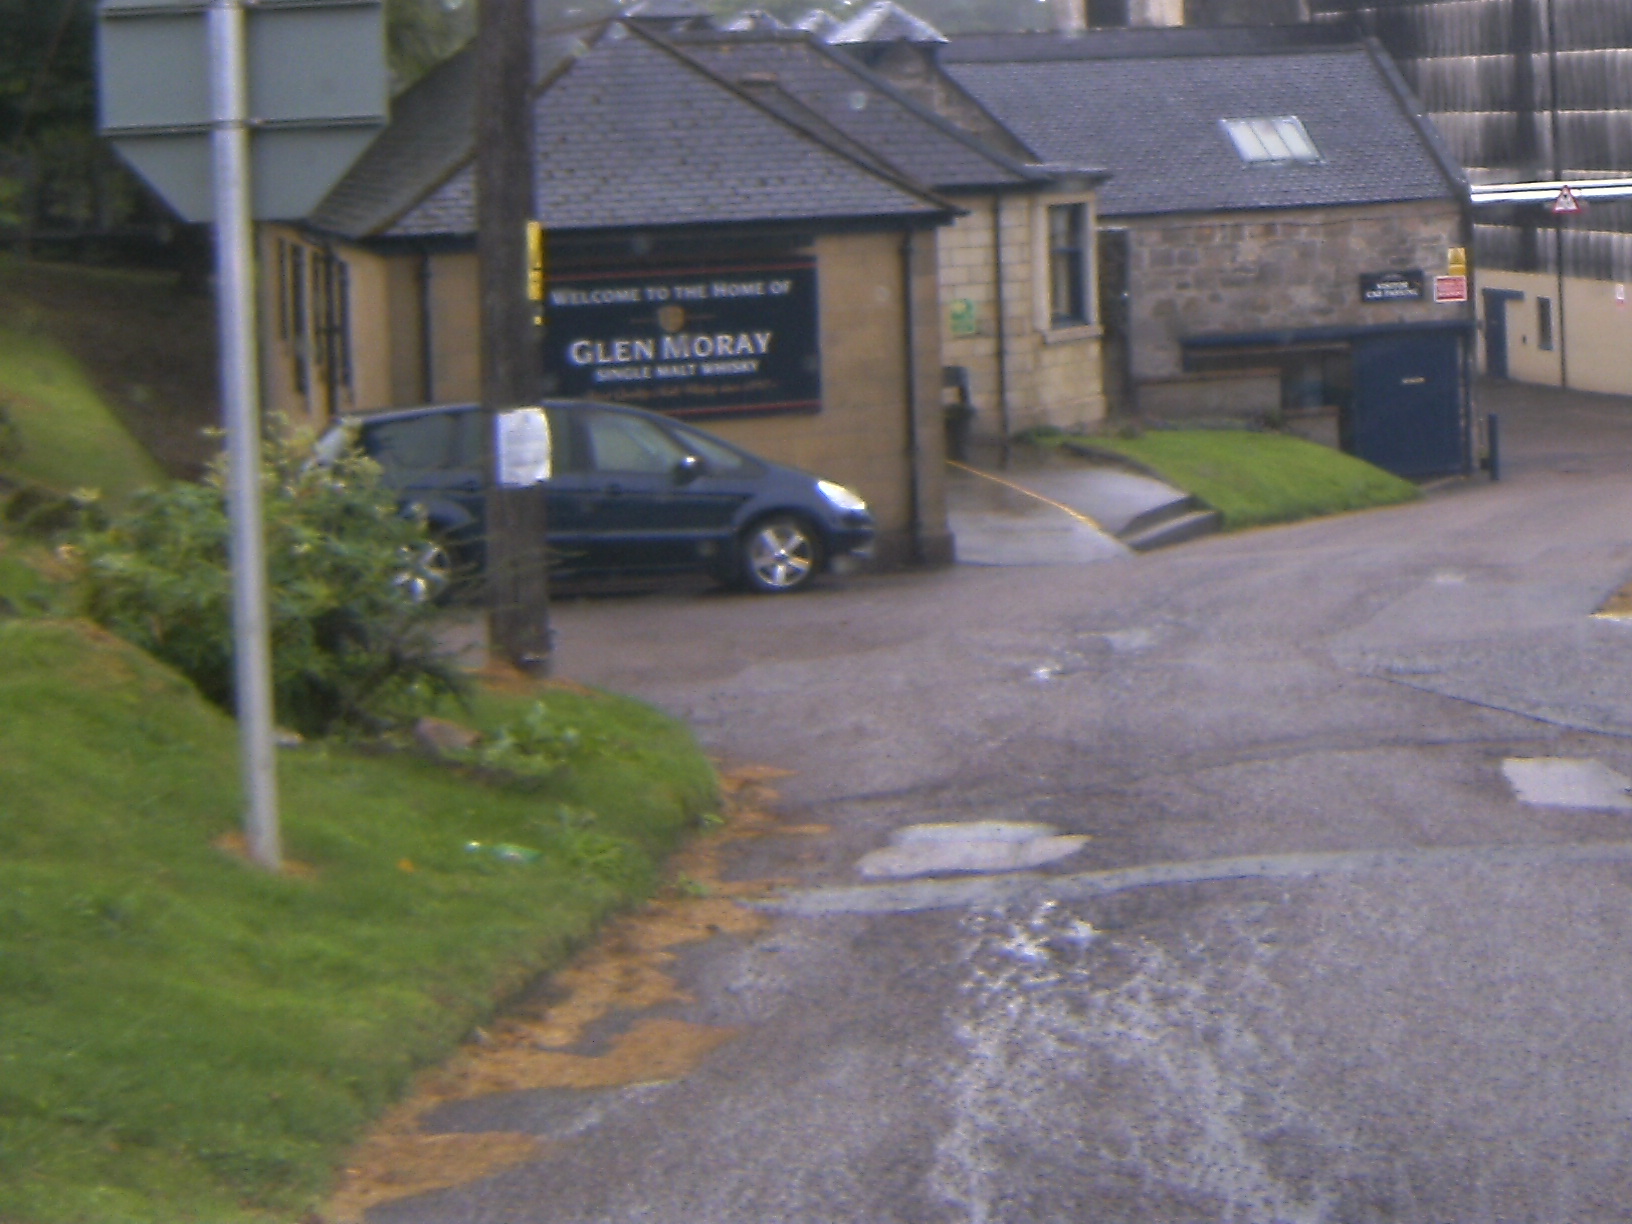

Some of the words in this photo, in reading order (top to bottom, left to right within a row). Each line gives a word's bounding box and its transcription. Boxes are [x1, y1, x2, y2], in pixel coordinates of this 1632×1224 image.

[551, 287, 640, 305] WELCOME
[645, 286, 669, 301] TO
[674, 284, 706, 299] THE
[711, 281, 764, 297] HOME
[769, 280, 792, 294] OF
[570, 339, 655, 365] GLEN
[662, 333, 772, 359] MORAY
[595, 366, 651, 381] SINGLE
[656, 363, 696, 377] MALT
